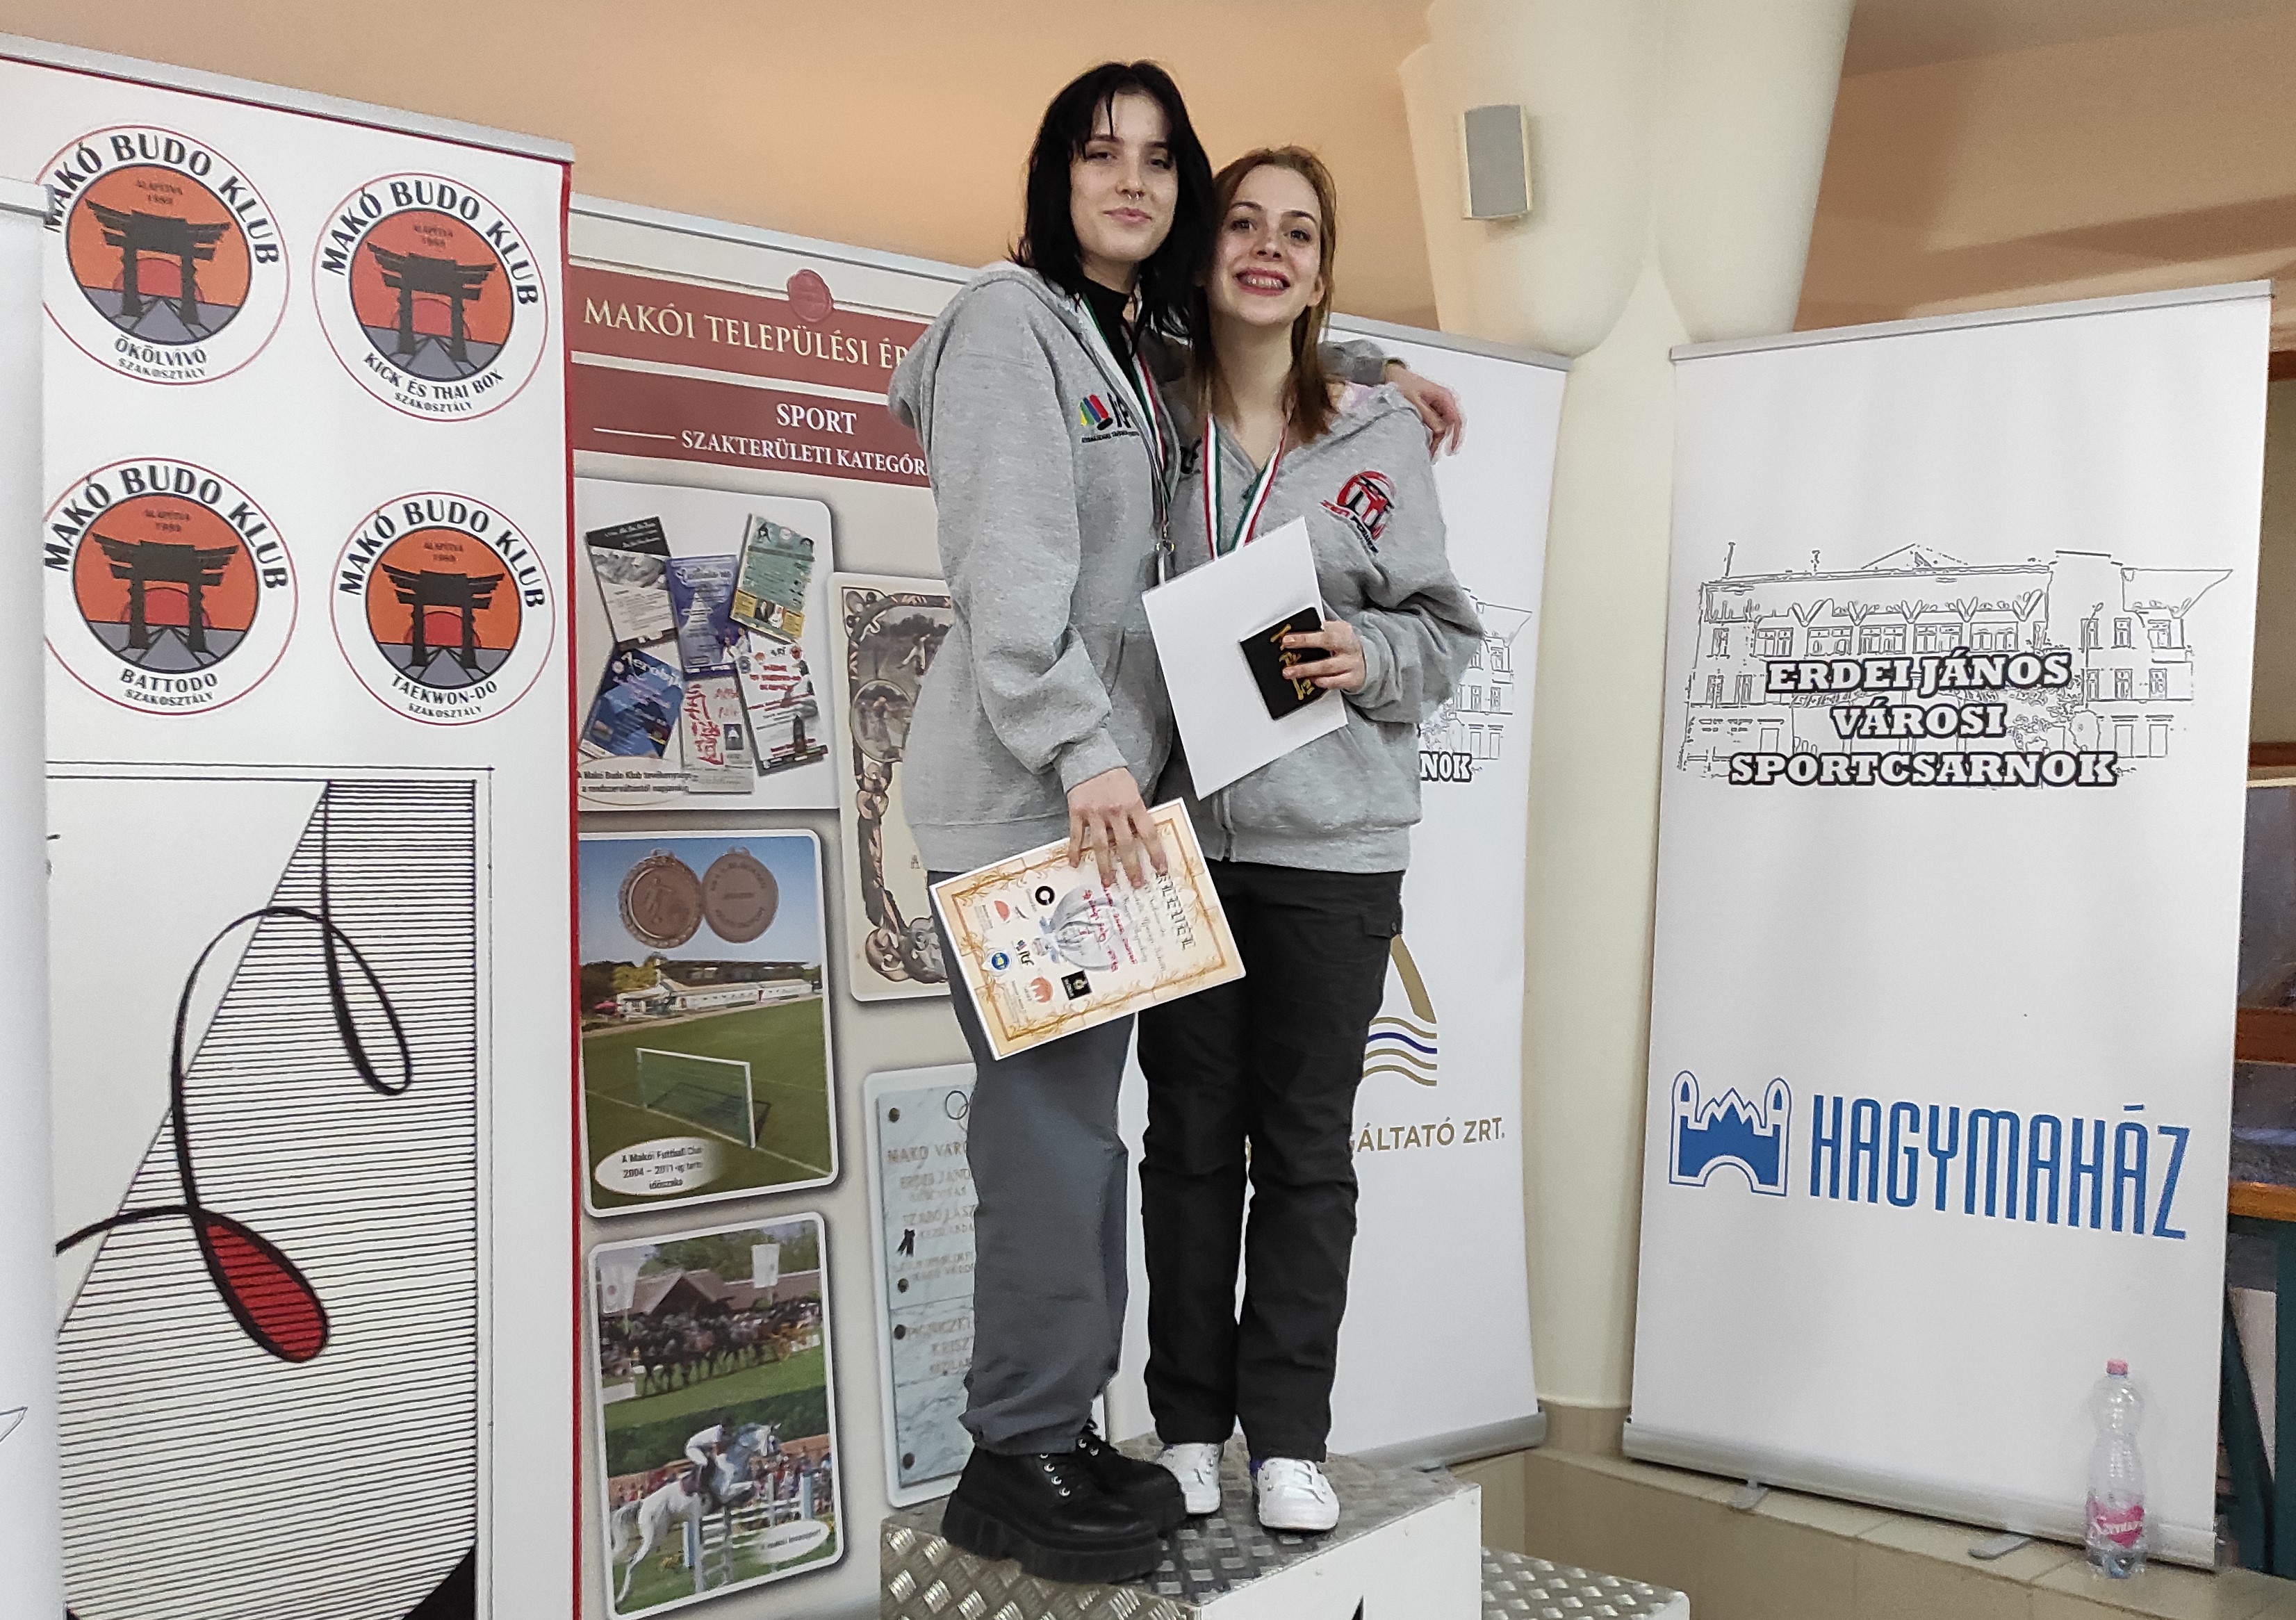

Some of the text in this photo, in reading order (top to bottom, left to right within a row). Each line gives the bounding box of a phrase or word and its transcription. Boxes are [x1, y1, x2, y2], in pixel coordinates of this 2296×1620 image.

[110, 133, 211, 177] BUDO
[219, 175, 279, 264] KLUB
[321, 179, 539, 305] MAKÓ BUDO KLUB
[584, 297, 696, 338] MAKÓI
[703, 313, 869, 366] TELEPÜLÉSI
[363, 352, 505, 400] KICK ÉS THAI BOX
[776, 402, 857, 436] SPORT
[681, 429, 833, 466] SZAKTERÜLETI
[44, 465, 288, 589] MAKÓ BUDO KLUB
[339, 498, 546, 608] MAKÓ BUDO KLUB
[120, 668, 218, 693] BATTODO
[391, 673, 498, 705] TAEKWON-DO
[1766, 647, 2072, 697] ERDEI JÁNOS
[1830, 697, 2008, 740] VÁROSI
[1419, 751, 1473, 783] NOK
[1729, 751, 2119, 787] SPORTCSARNOK
[1350, 1116, 1505, 1152] ÁLTATÓ ZRT.
[1809, 1094, 2191, 1241] HAGYMAHÁZ
